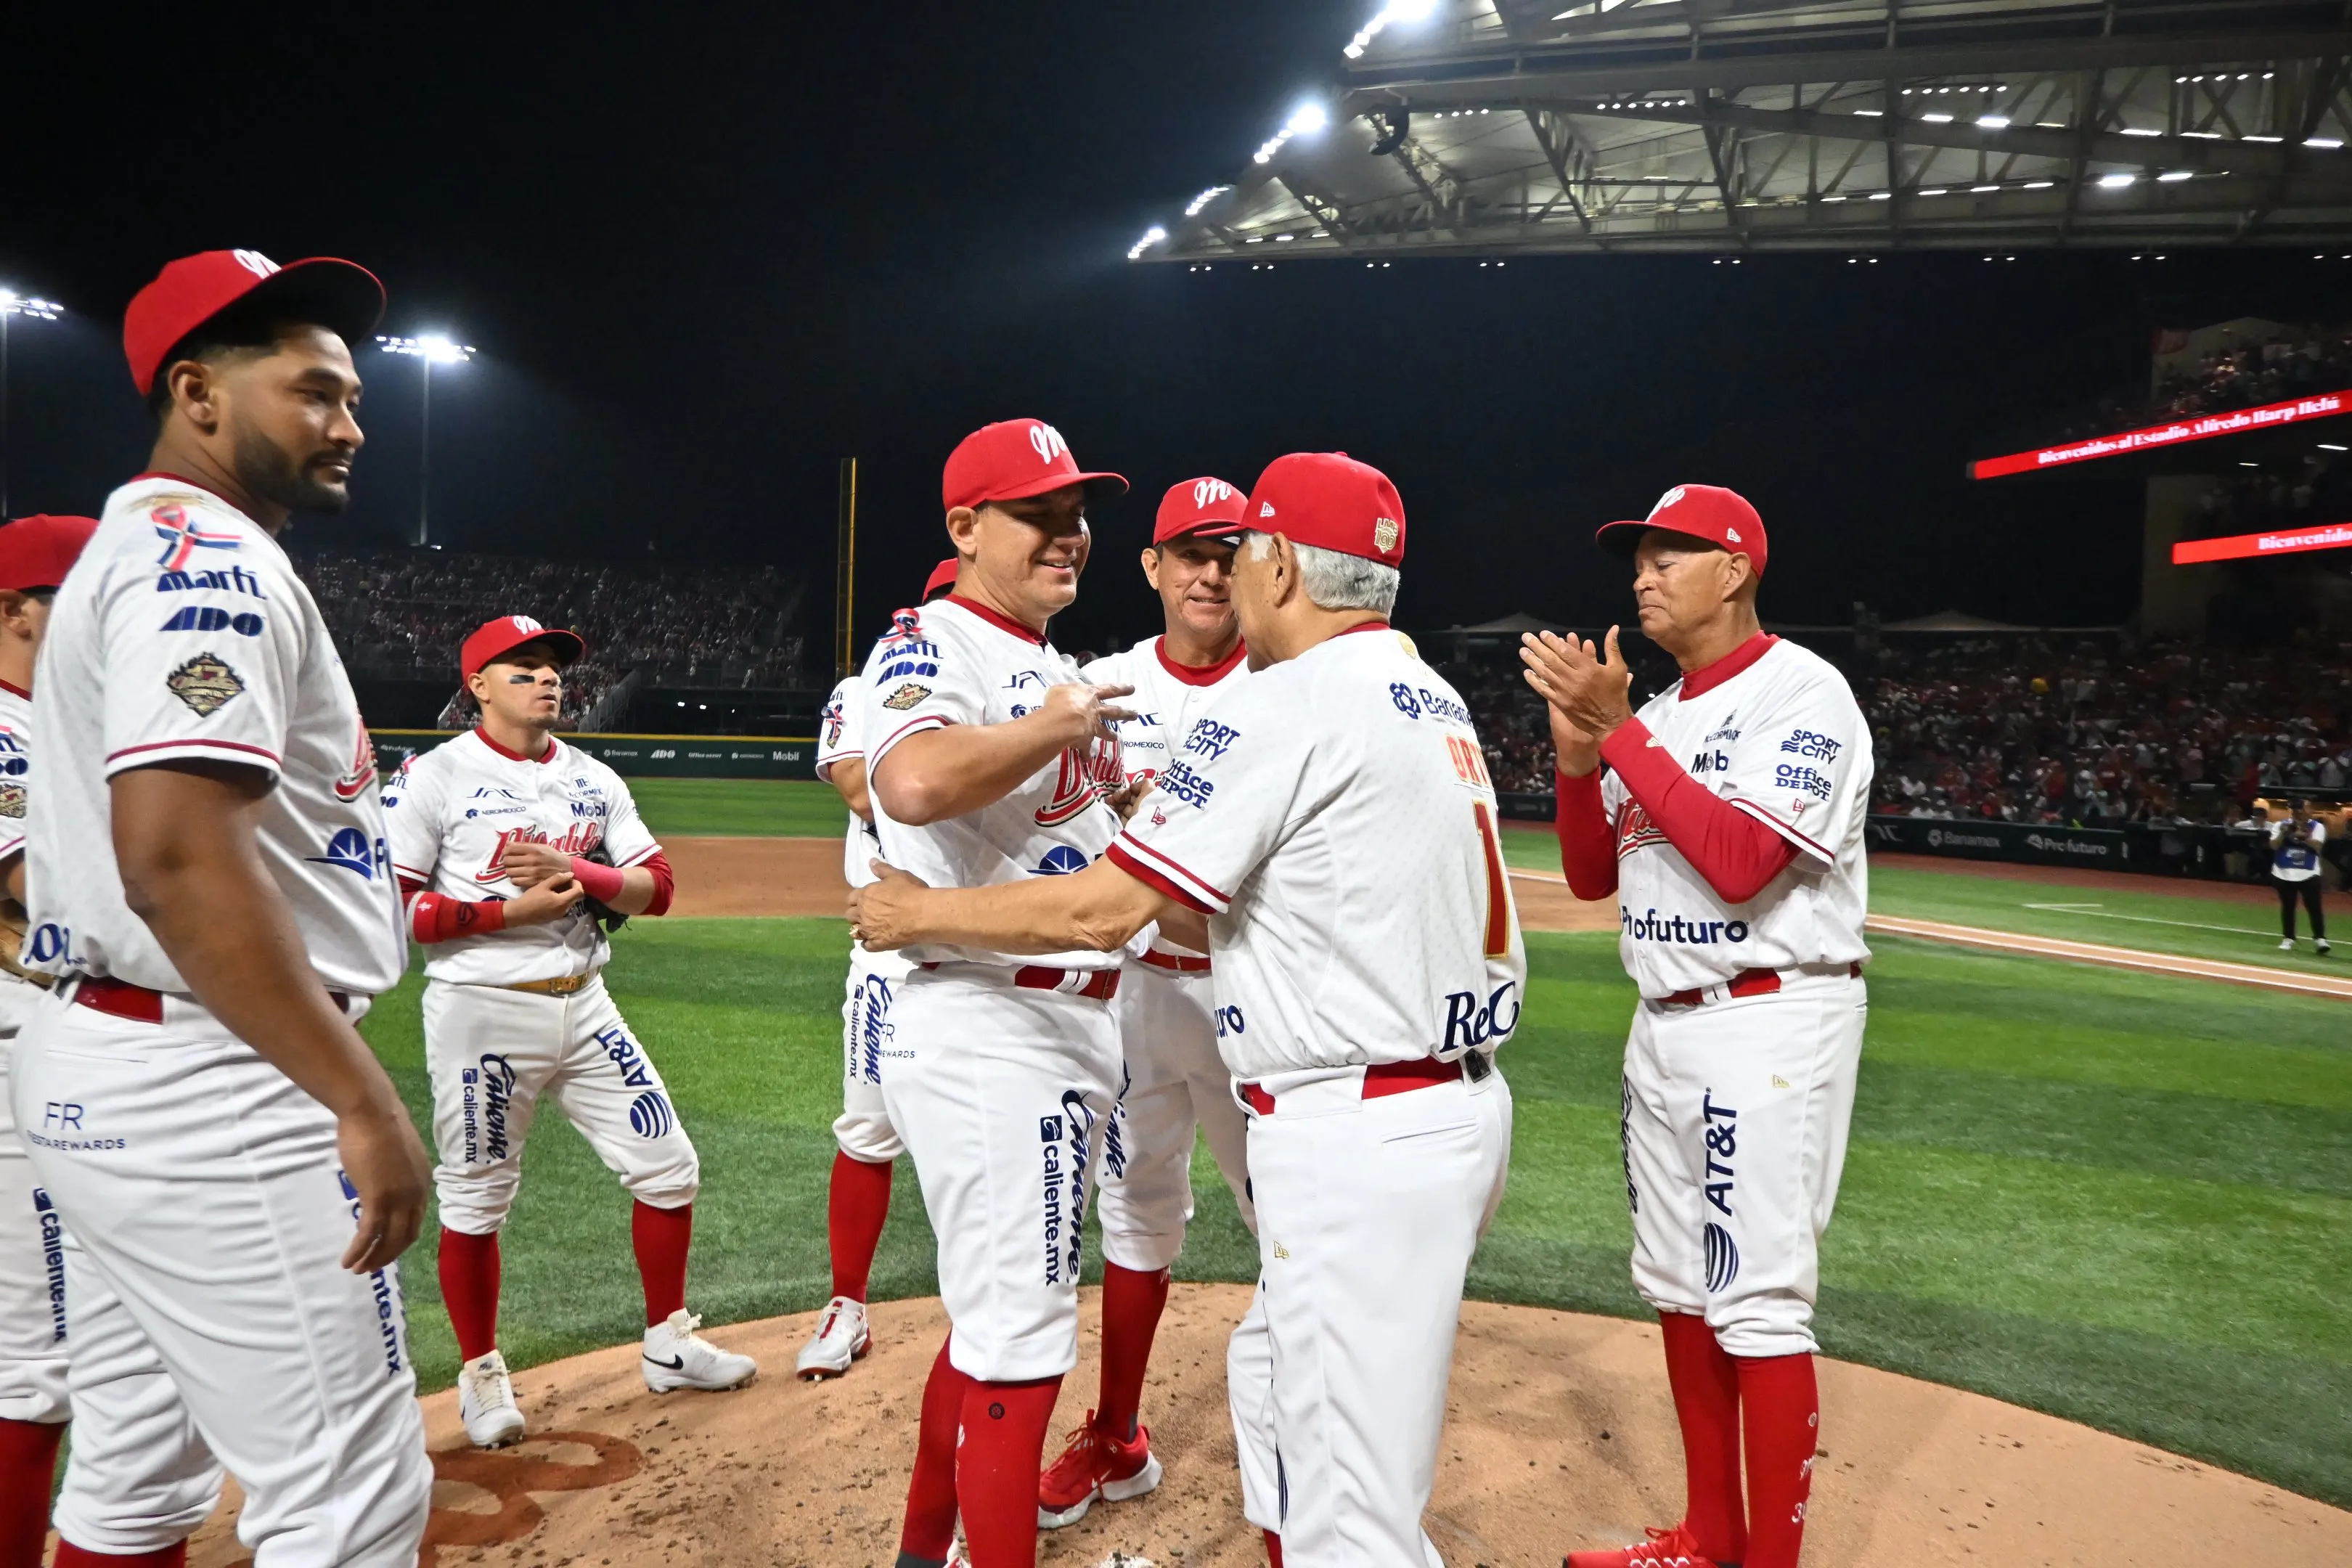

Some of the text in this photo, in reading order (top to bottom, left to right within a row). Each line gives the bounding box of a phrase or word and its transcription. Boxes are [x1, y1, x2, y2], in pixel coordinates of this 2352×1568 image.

[2118, 436, 2133, 449] al
[2134, 426, 2189, 446] Estadio
[2191, 415, 2251, 435] Alfredo
[2253, 407, 2296, 422] Harp
[159, 605, 263, 637] ADO
[875, 661, 938, 688] ADO
[1418, 688, 1474, 728] Baname
[650, 748, 676, 759] ADO
[1123, 740, 1164, 749] ROMEXICO
[1186, 735, 1228, 761] CITY
[1791, 729, 1842, 754] SPORT
[1801, 745, 1837, 764] CITY
[772, 751, 800, 761] Mobil
[1691, 749, 1729, 774] Mob
[1774, 777, 1831, 802] DEPOT
[1776, 764, 1832, 792] Office
[571, 801, 607, 817] Mobi
[1944, 831, 2001, 848] Banamex
[849, 1001, 860, 1079] caliente.mx
[592, 1028, 654, 1087] AT&T
[878, 1050, 916, 1058] REWARDS
[44, 1101, 83, 1130] FR
[463, 1085, 478, 1163] caliente.mx
[1703, 1093, 1737, 1217] AT&T
[1043, 1145, 1064, 1286] caliente.mx
